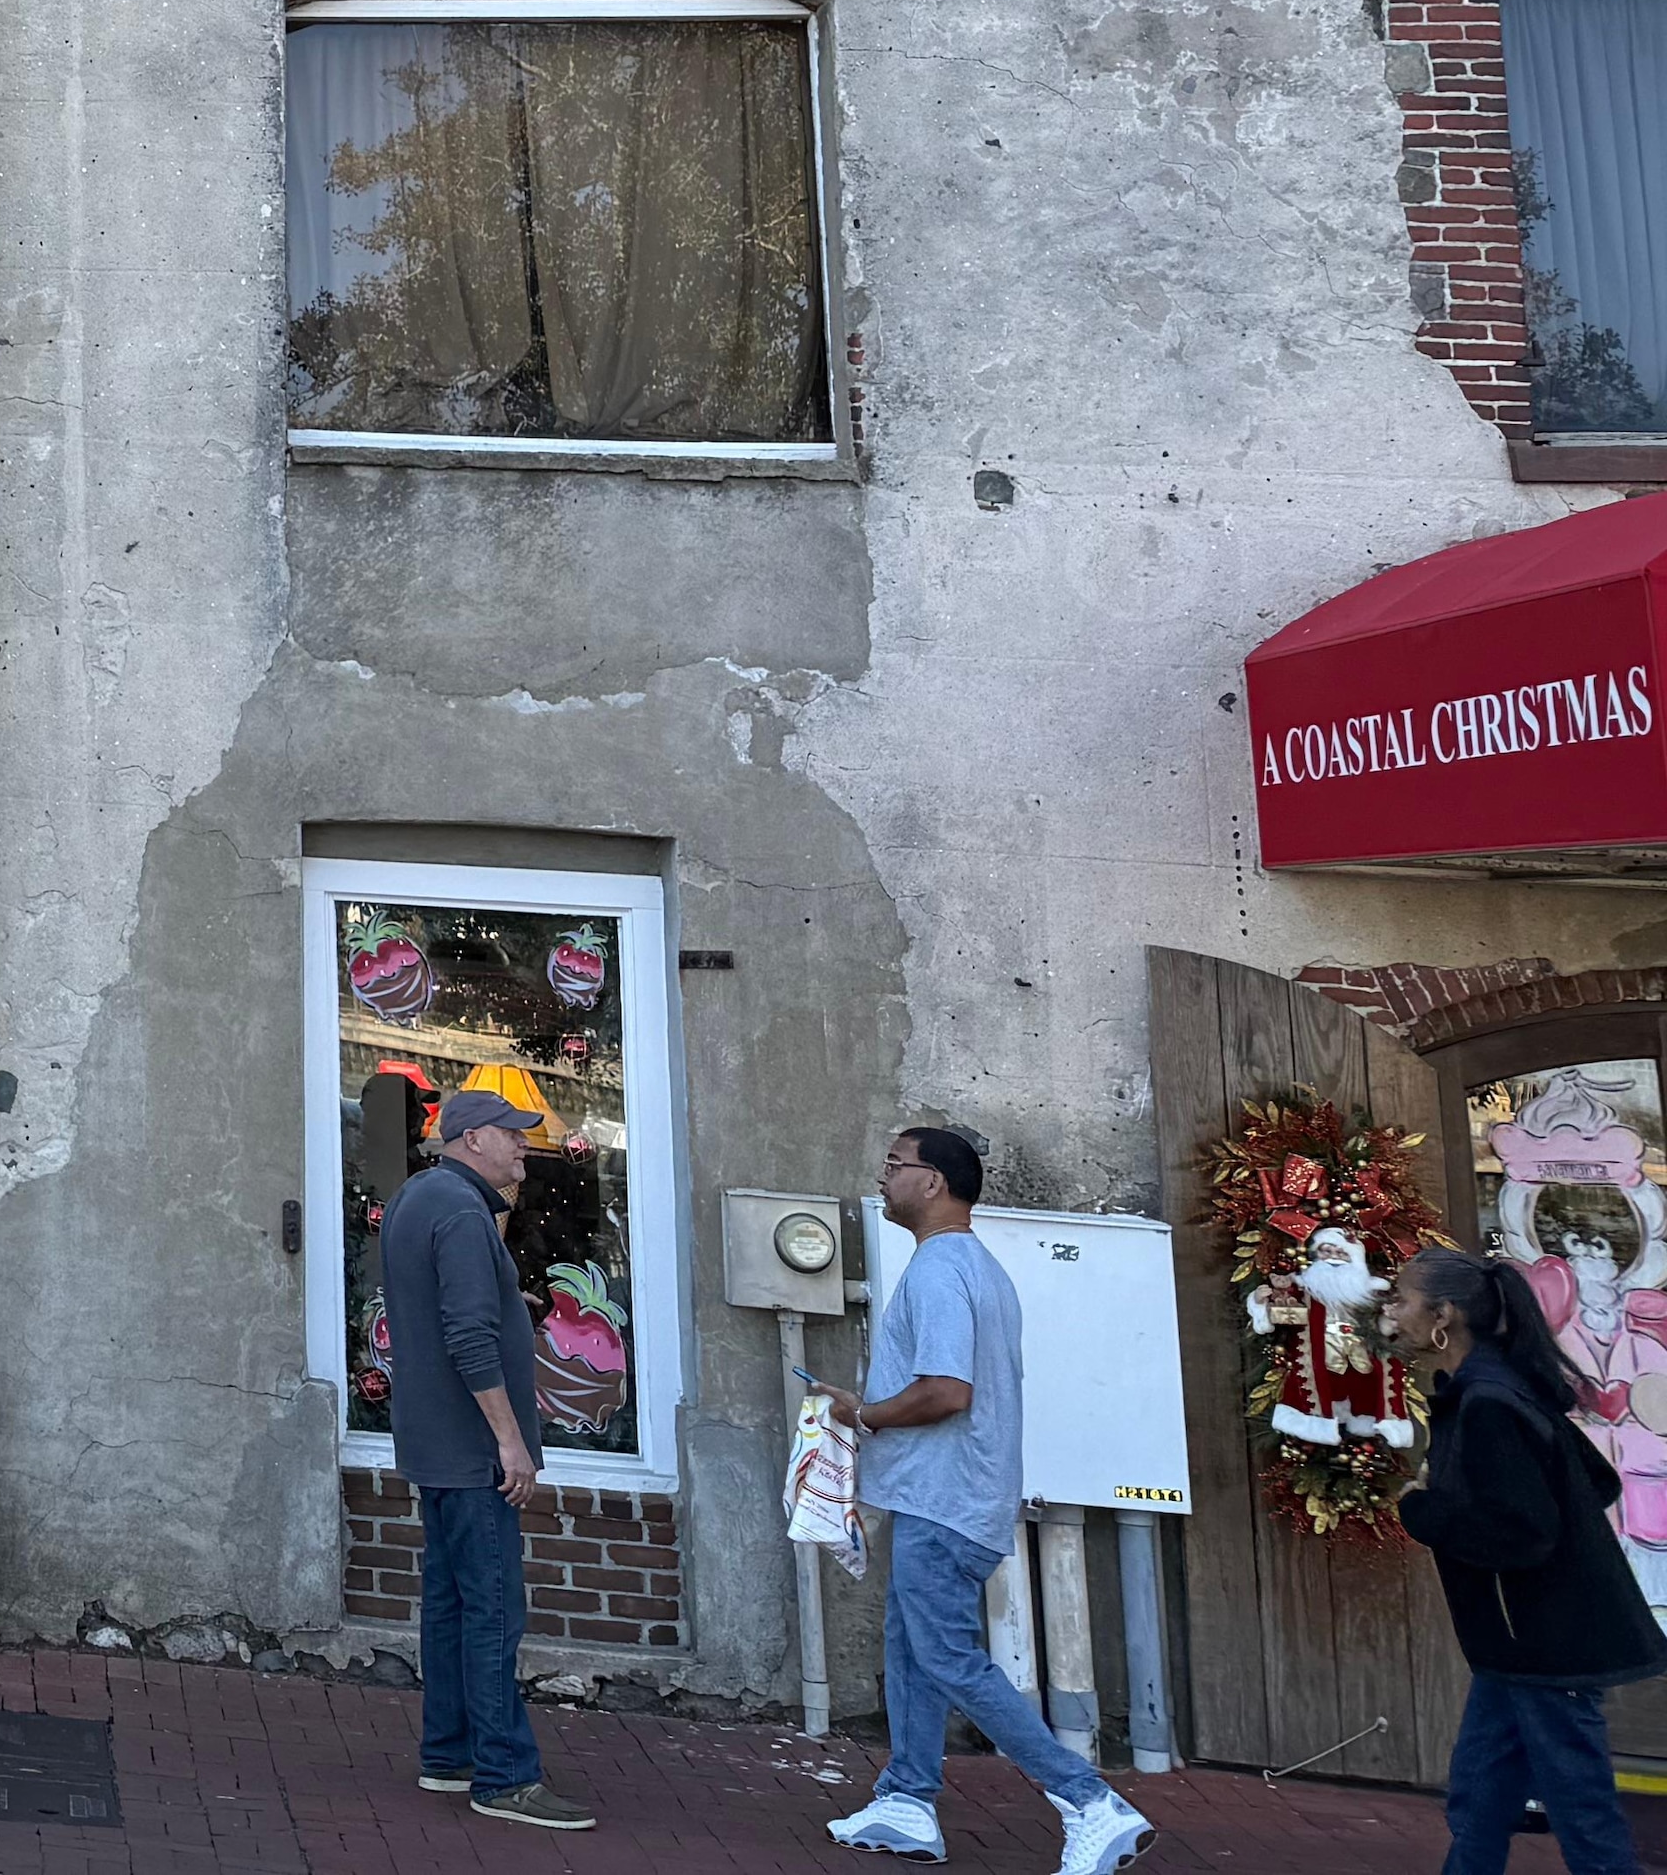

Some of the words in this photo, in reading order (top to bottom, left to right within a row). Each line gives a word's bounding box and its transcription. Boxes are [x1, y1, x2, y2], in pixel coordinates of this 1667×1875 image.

[1262, 732, 1283, 787] A
[1285, 707, 1427, 784] COASTAL
[1430, 665, 1653, 765] CHRISTMAS
